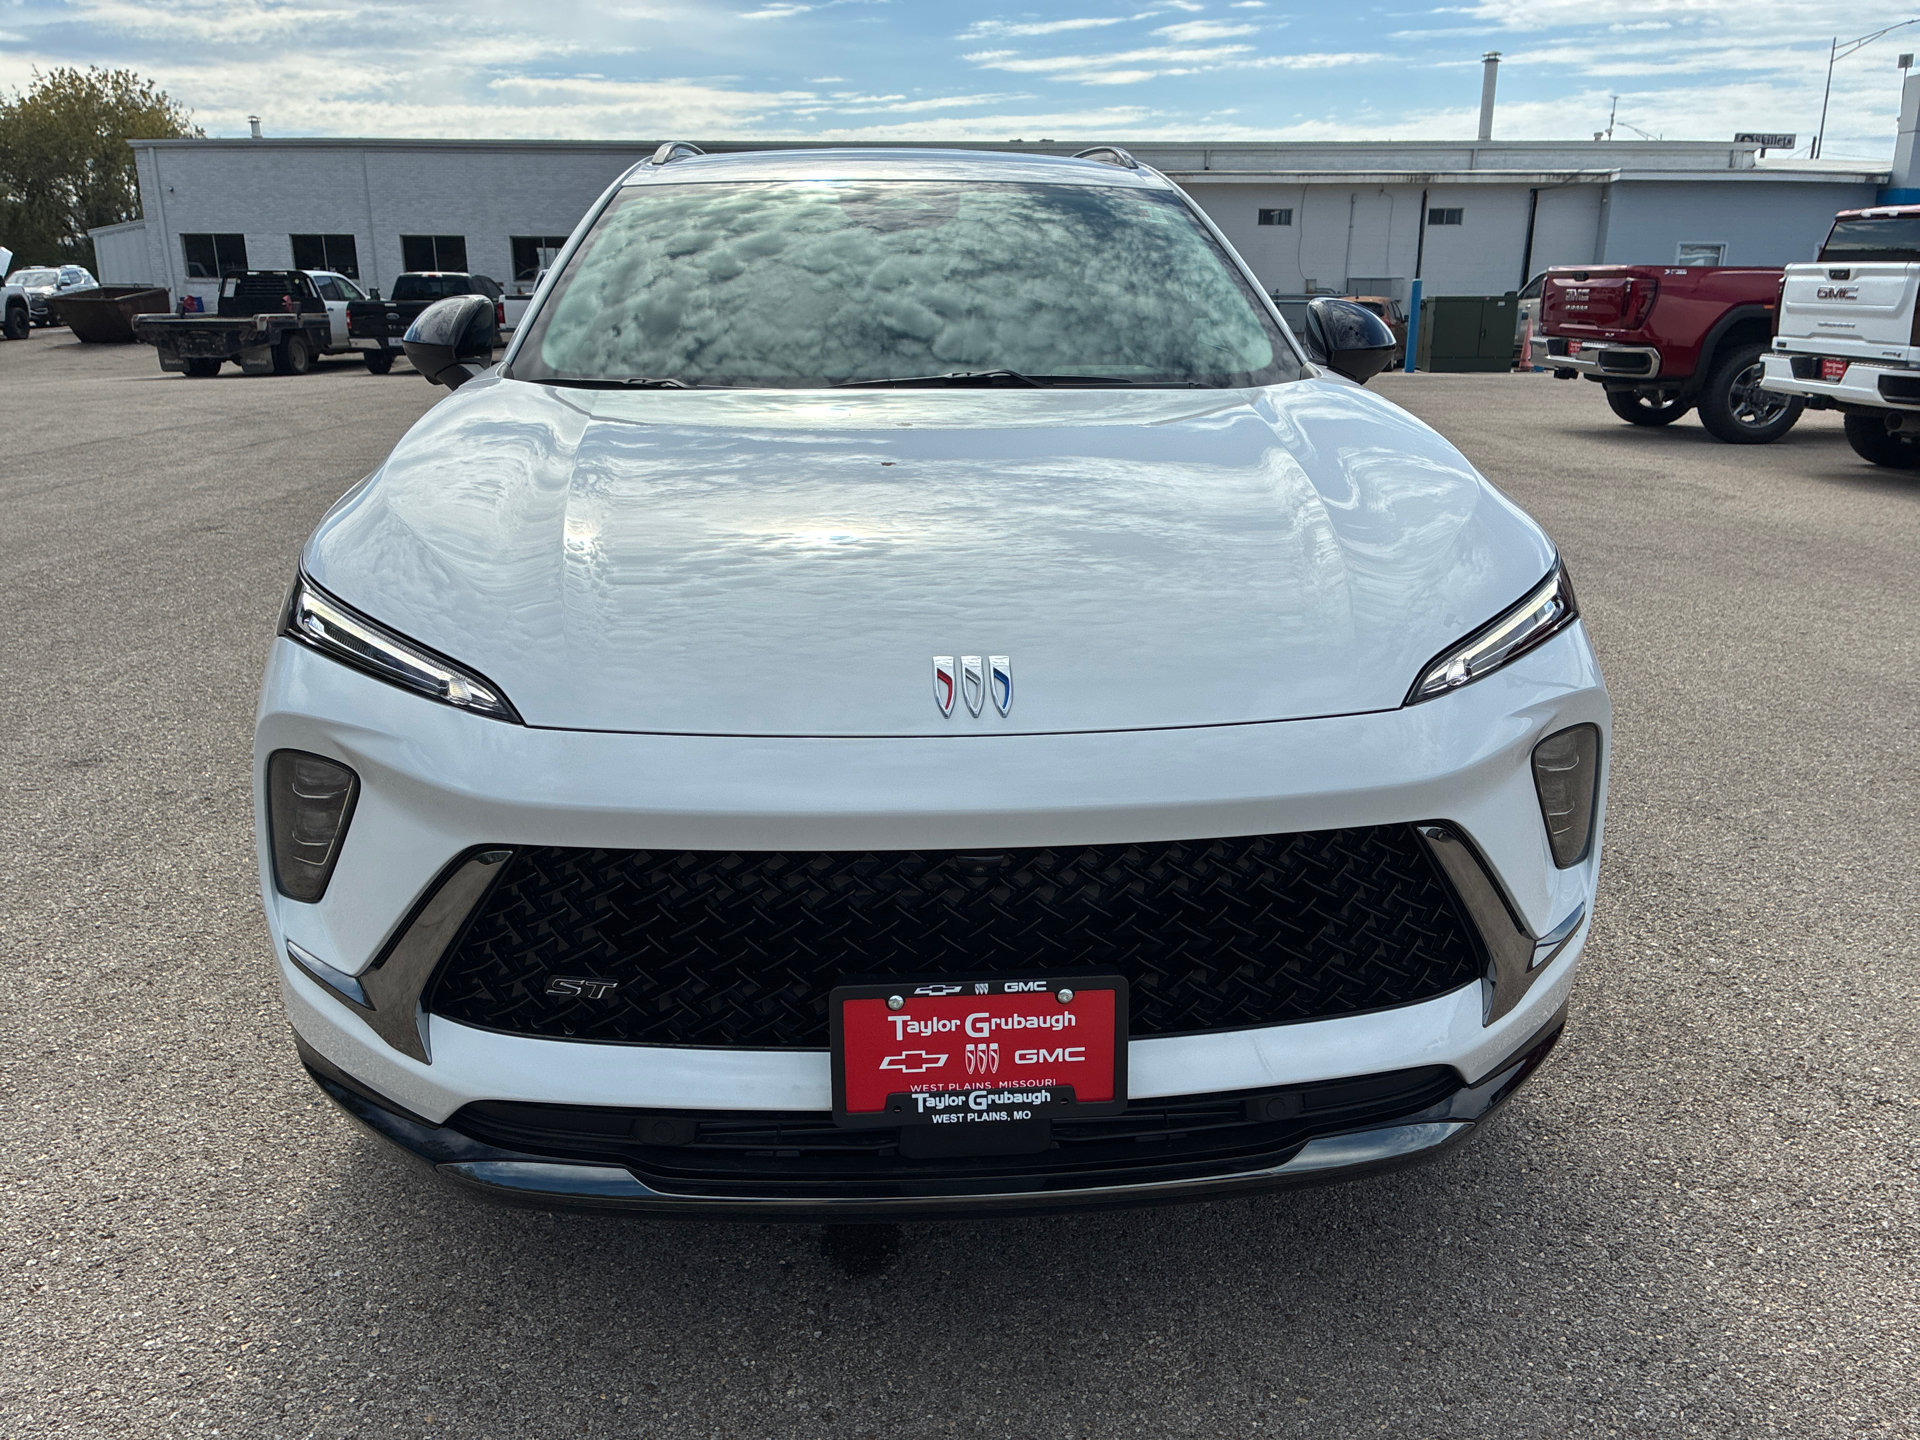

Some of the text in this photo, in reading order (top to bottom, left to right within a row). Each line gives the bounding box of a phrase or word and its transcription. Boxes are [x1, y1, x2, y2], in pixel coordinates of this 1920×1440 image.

[1816, 285, 1860, 300] GMC
[545, 978, 619, 1000] ST
[1004, 981, 1047, 992] GMC
[888, 1011, 1076, 1041] Taylor Grubaugh
[1014, 1046, 1086, 1065] GMC
[910, 1083, 945, 1093] WEST
[999, 1078, 1056, 1089] MISSOURI
[911, 1090, 1051, 1113] Taylor Grubaugh
[932, 1110, 1032, 1124] WEST PLAINS, MO
